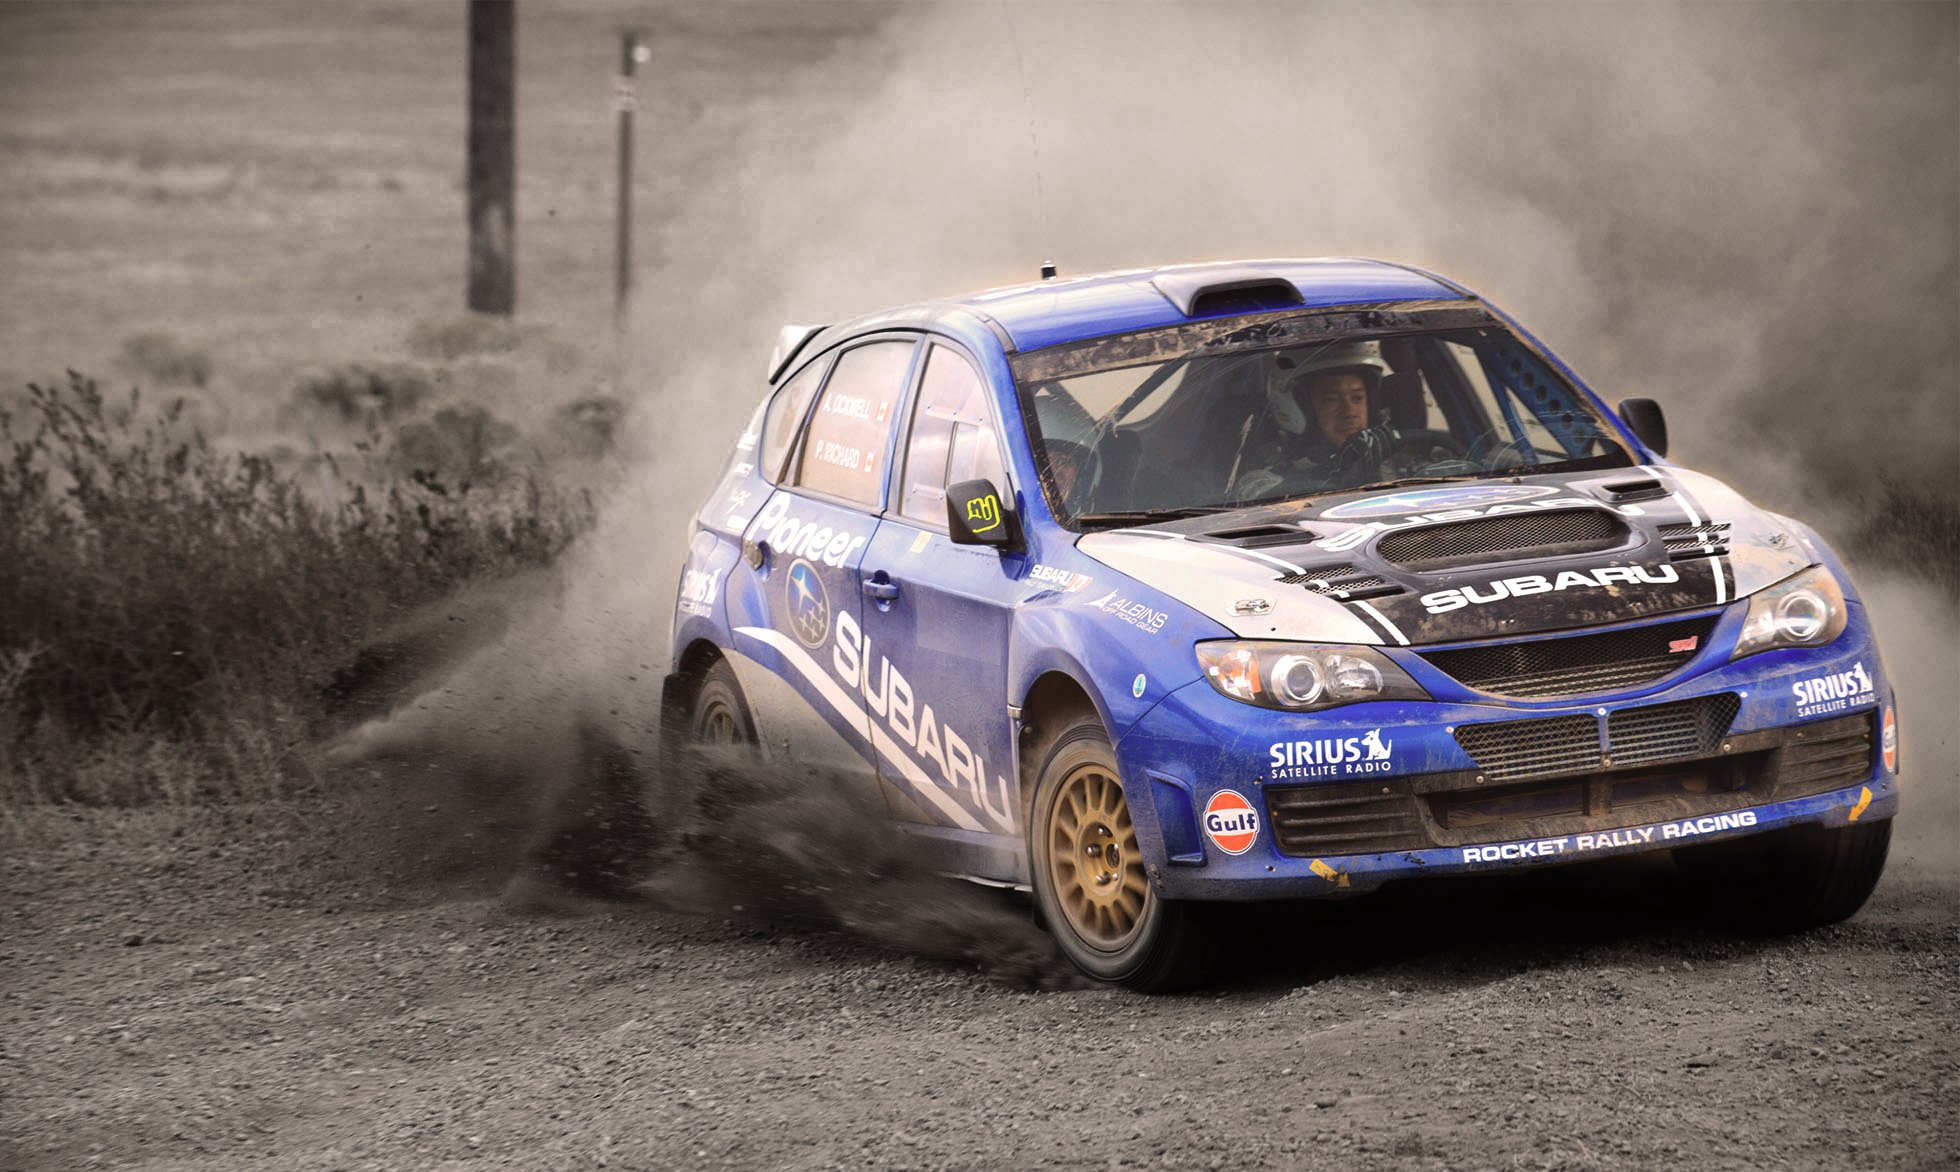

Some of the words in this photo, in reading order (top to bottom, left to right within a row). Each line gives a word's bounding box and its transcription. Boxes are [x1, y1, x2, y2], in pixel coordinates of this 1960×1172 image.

[745, 492, 865, 568] Pioneer
[1029, 564, 1074, 586] SUBARU
[1420, 563, 1680, 614] SUBARU
[1109, 599, 1168, 628] ALBINS
[1136, 621, 1158, 634] GEAR
[1792, 671, 1858, 706] SIRIUS
[833, 610, 1016, 835] SUBARU
[1797, 699, 1847, 717] SATELLITE
[1269, 737, 1361, 767] SIRIUS
[1271, 765, 1337, 779] SATELLITE
[1345, 761, 1392, 774] RADIO
[1207, 813, 1256, 833] Gulf
[1462, 838, 1568, 863] ROCKET
[1577, 827, 1654, 851] RALLY
[1662, 811, 1757, 839] RACING
